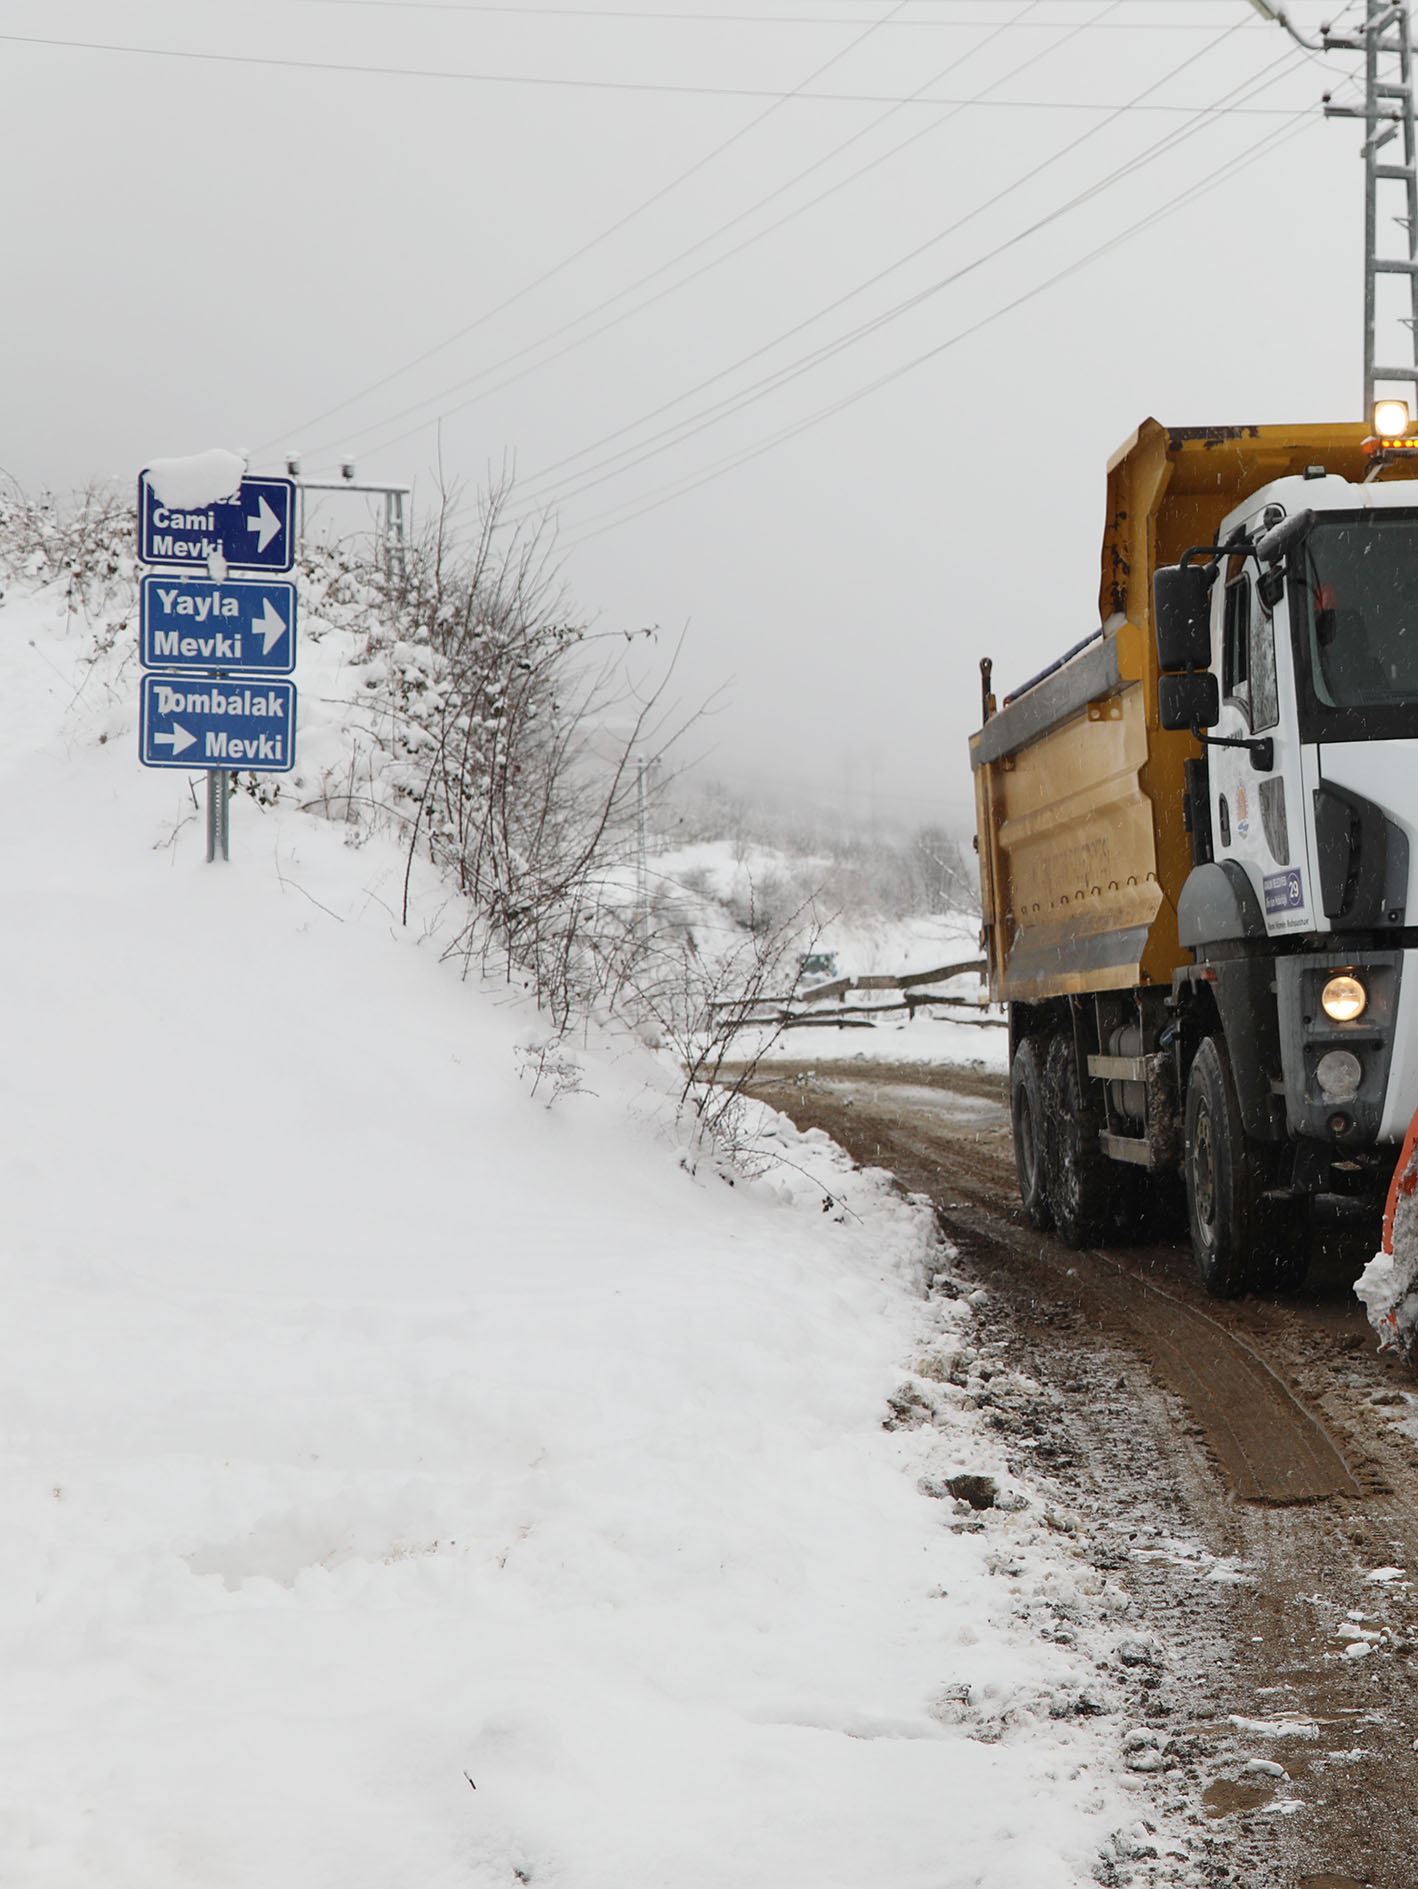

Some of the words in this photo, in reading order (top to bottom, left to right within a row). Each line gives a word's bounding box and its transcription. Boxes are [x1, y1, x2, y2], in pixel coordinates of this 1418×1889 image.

[152, 507, 215, 531] Cami
[156, 588, 239, 622] Yayla
[153, 631, 242, 659] Mevki
[153, 686, 284, 717] Tombalak
[205, 732, 282, 760] Mevki
[1288, 881, 1299, 898] 29
